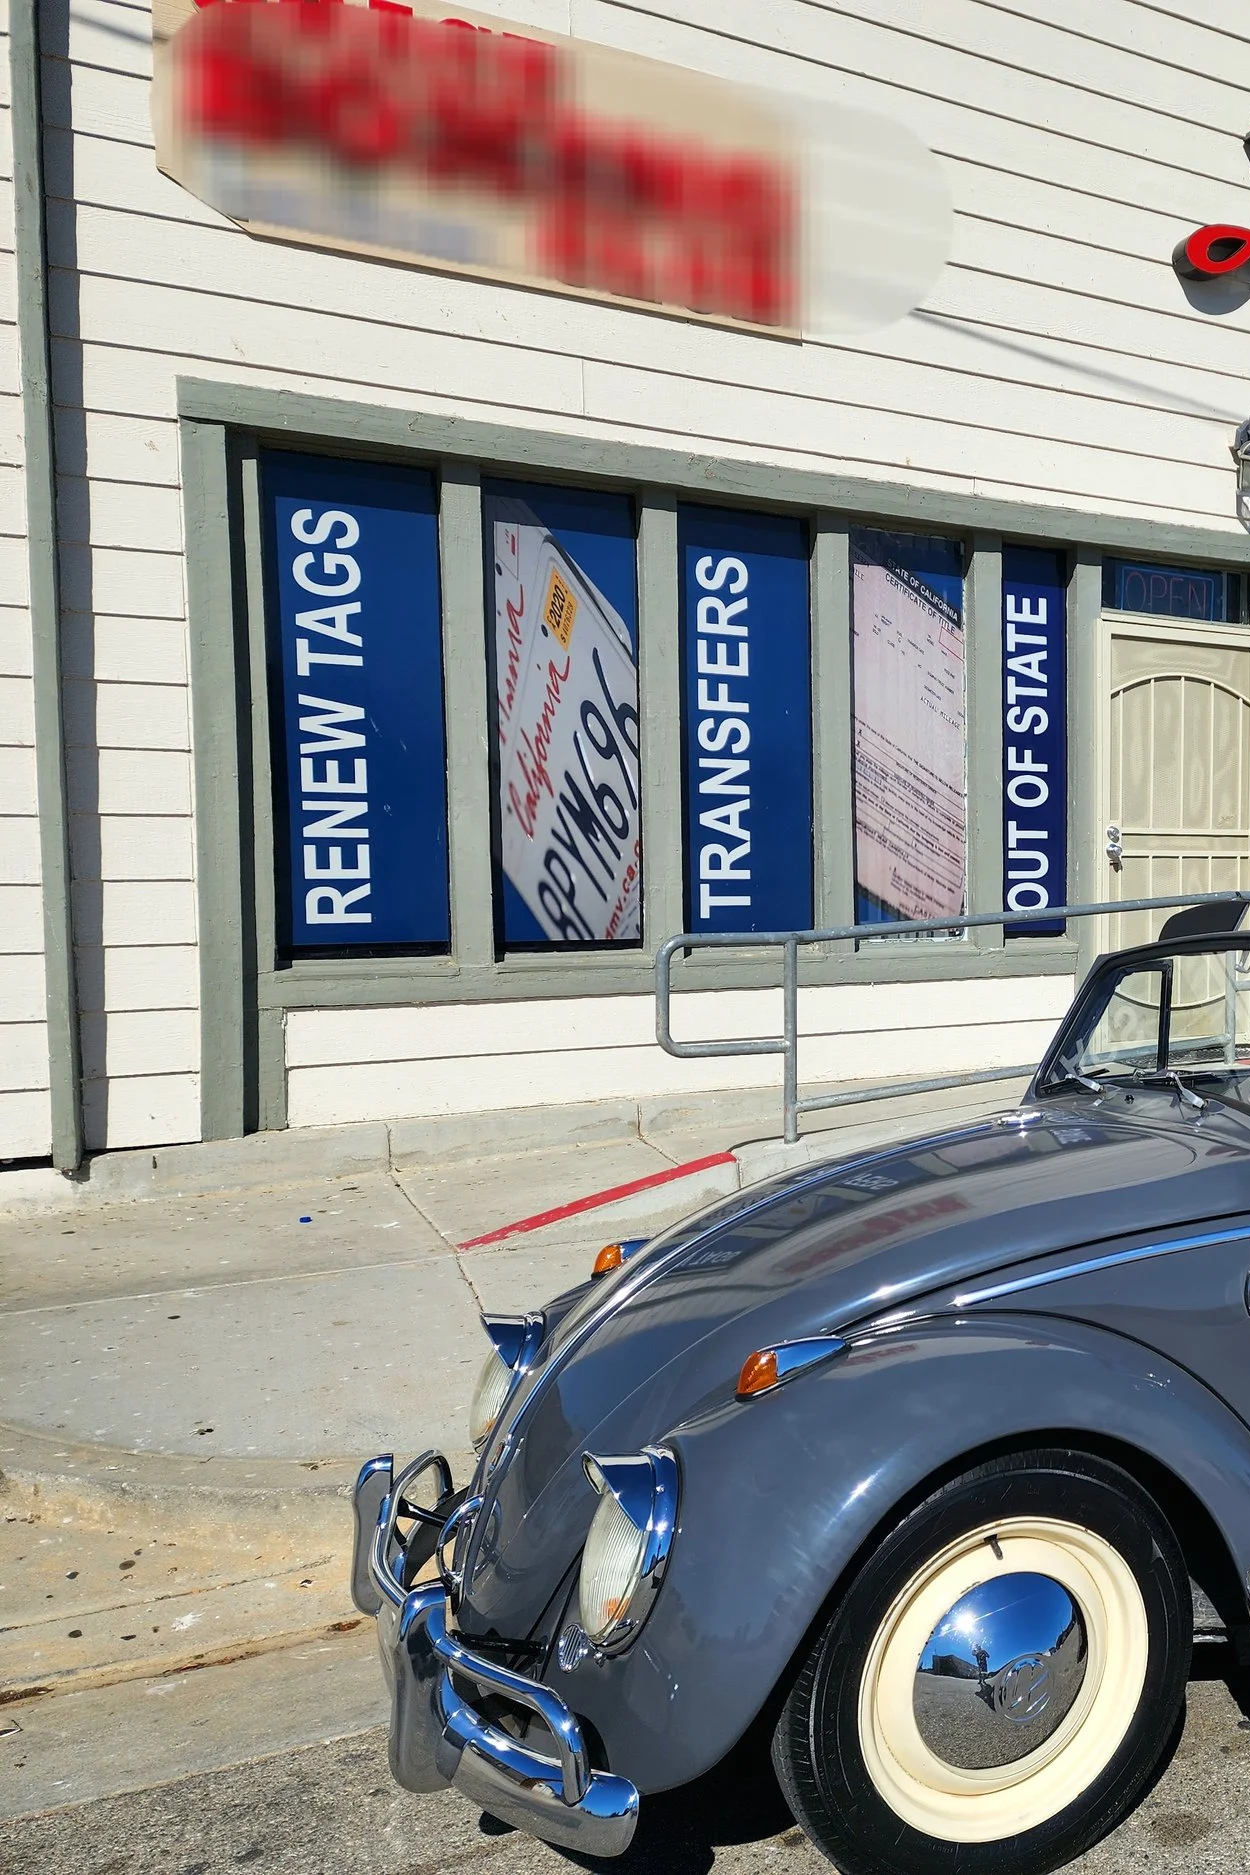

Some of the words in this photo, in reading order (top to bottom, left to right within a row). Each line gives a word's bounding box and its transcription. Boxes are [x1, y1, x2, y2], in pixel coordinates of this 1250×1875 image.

[291, 508, 364, 677] TAGS
[549, 584, 566, 629] 2020
[885, 573, 926, 612] CERTIFICATE
[927, 608, 937, 619] OF
[938, 616, 956, 635] TITLE
[887, 558, 909, 581] STATE
[910, 576, 919, 588] OF
[920, 586, 958, 622] CALIFORNIA
[1125, 571, 1207, 618] OPEN
[1006, 594, 1049, 735] STATE
[508, 656, 570, 838] California
[695, 555, 751, 919] TRANSFERS
[1007, 749, 1049, 808] OF
[299, 693, 373, 926] RENEW
[1007, 820, 1049, 911] OUT
